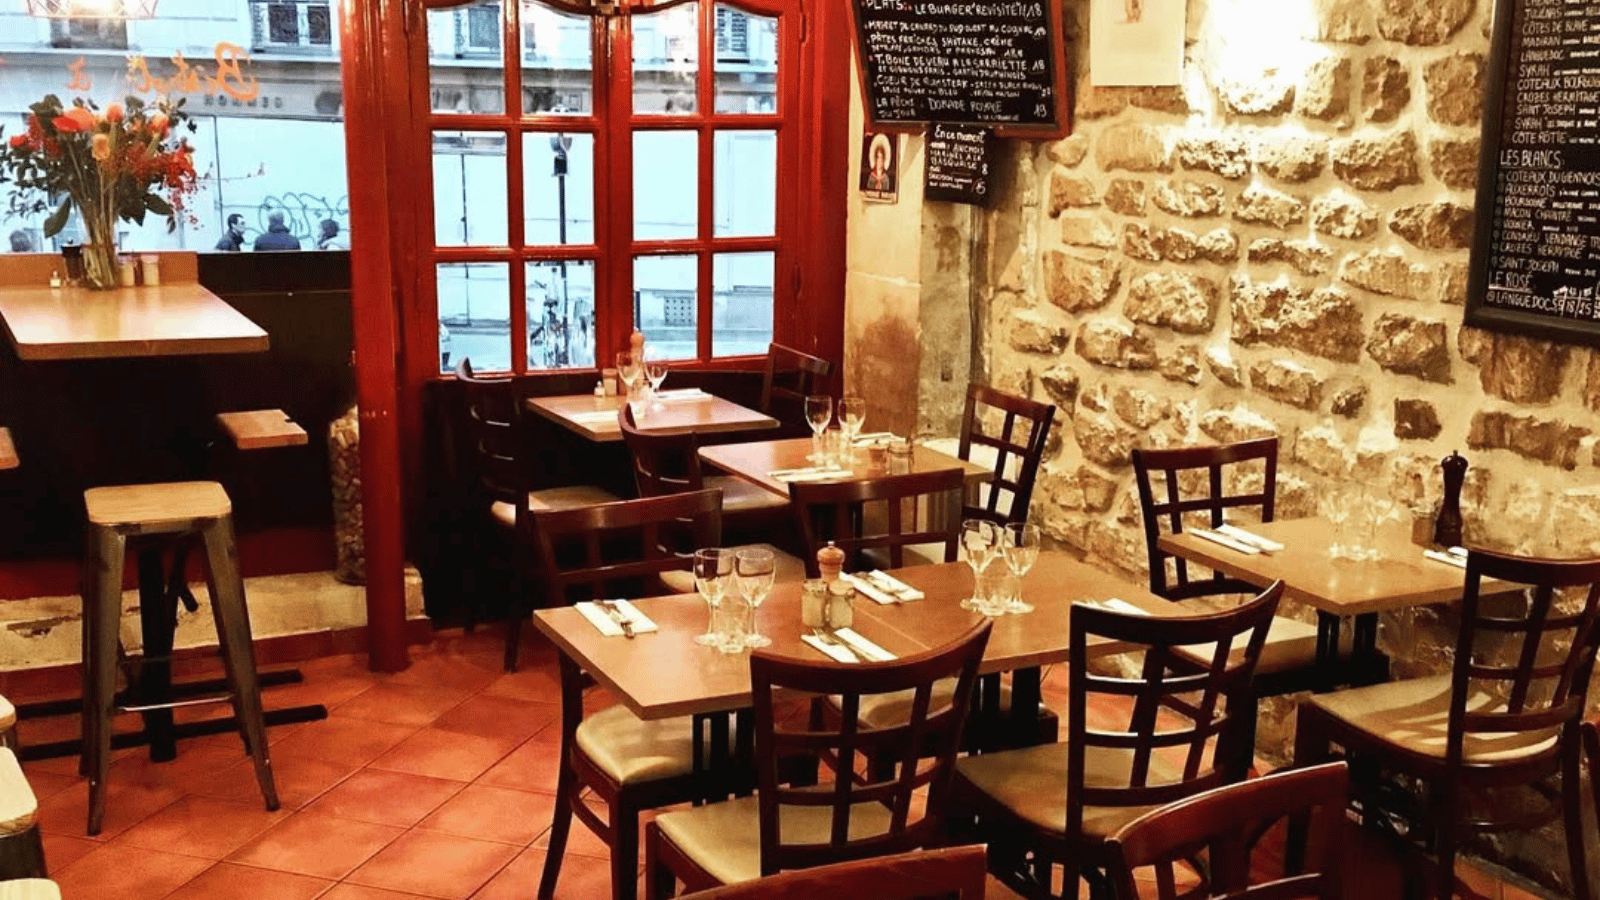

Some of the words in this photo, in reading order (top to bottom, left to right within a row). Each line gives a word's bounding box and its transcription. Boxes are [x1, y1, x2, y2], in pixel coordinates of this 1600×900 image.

[928, 3, 973, 16] BURGER
[1519, 63, 1551, 78] SYRAH
[1516, 103, 1541, 116] SAINT
[1542, 103, 1576, 116] JOSEPH
[934, 124, 946, 138] En
[1500, 149, 1520, 166] LES
[1505, 170, 1547, 184] COTEAUX
